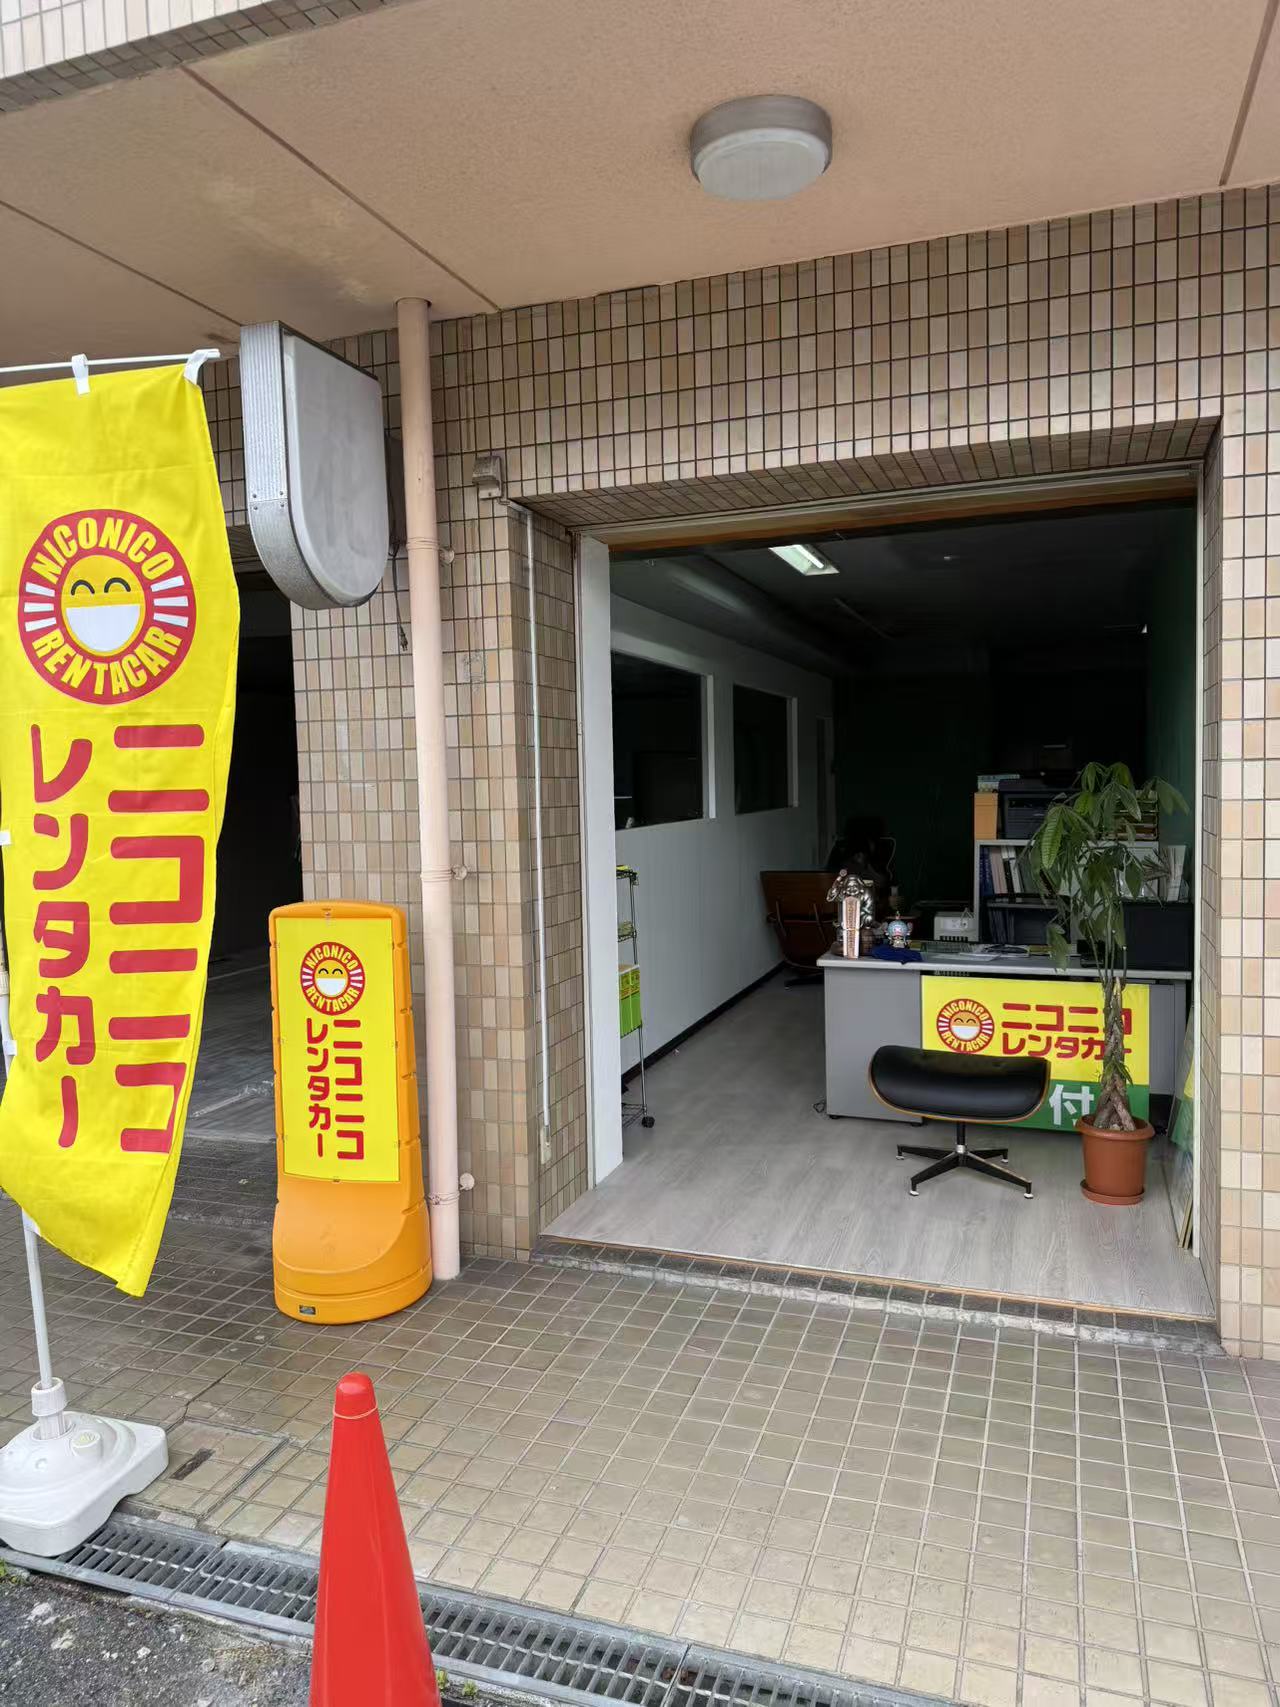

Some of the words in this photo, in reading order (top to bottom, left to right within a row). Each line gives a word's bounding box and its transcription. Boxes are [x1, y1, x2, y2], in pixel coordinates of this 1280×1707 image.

[31, 517, 175, 584] NICONICO
[32, 626, 183, 695] RENTACAR
[31, 724, 96, 1148] レンタカー
[108, 724, 210, 1153] ニコニコ
[305, 945, 358, 970] NICONICO
[305, 986, 360, 1012] RENTACAR
[941, 1000, 990, 1020] NICONICO
[941, 1031, 990, 1051] RENTACAR
[306, 1017, 331, 1158] レンタカー
[333, 1019, 365, 1160] ニコニコ
